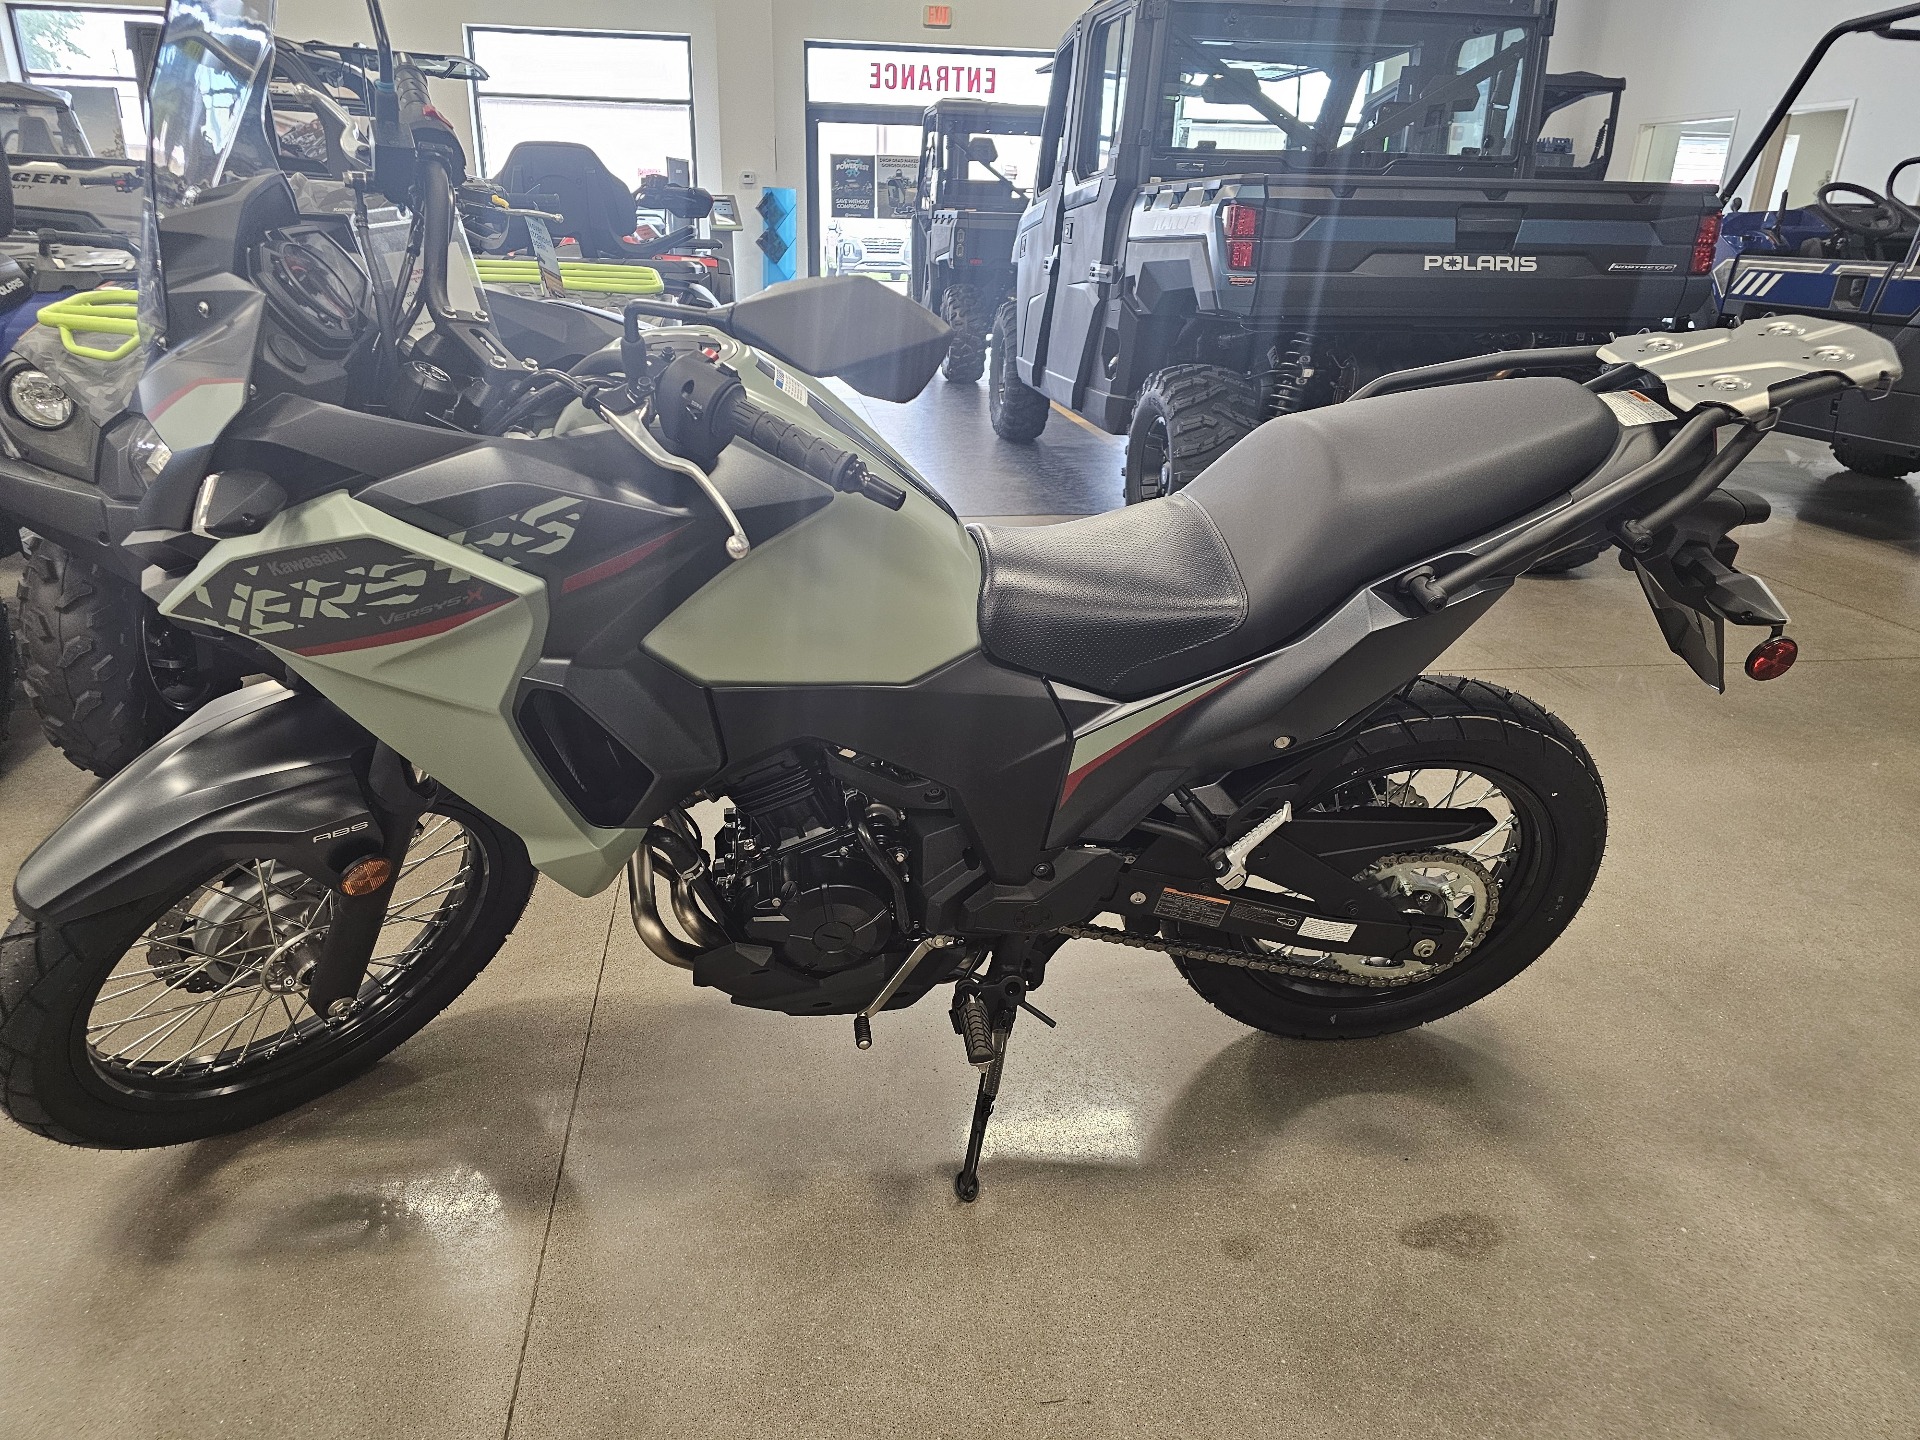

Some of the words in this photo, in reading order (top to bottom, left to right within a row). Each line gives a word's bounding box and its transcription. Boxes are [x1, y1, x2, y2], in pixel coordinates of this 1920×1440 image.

[928, 6, 949, 24] EXIT
[1424, 256, 1538, 272] POLARIS
[267, 548, 348, 576] Kawasaki
[313, 821, 368, 843] ABS
